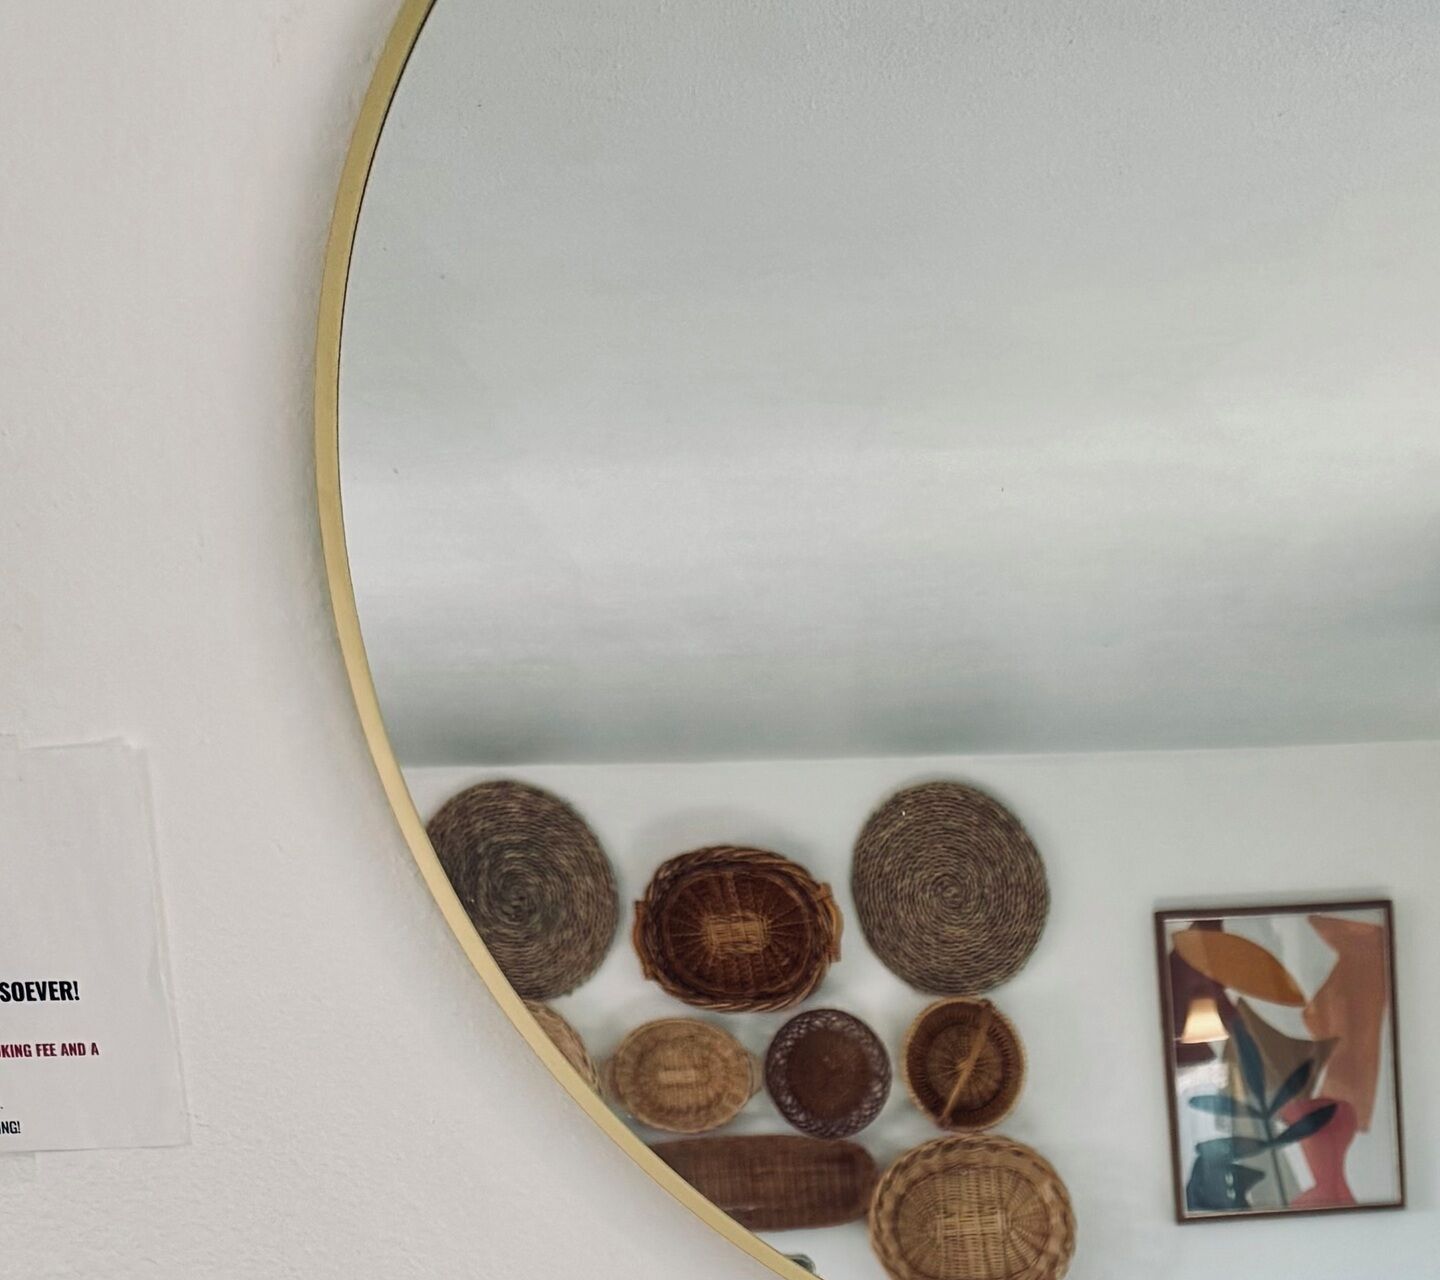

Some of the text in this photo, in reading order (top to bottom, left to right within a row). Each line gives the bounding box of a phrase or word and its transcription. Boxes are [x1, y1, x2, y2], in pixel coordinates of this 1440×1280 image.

[0, 1042, 99, 1058] KING FEE AND A
